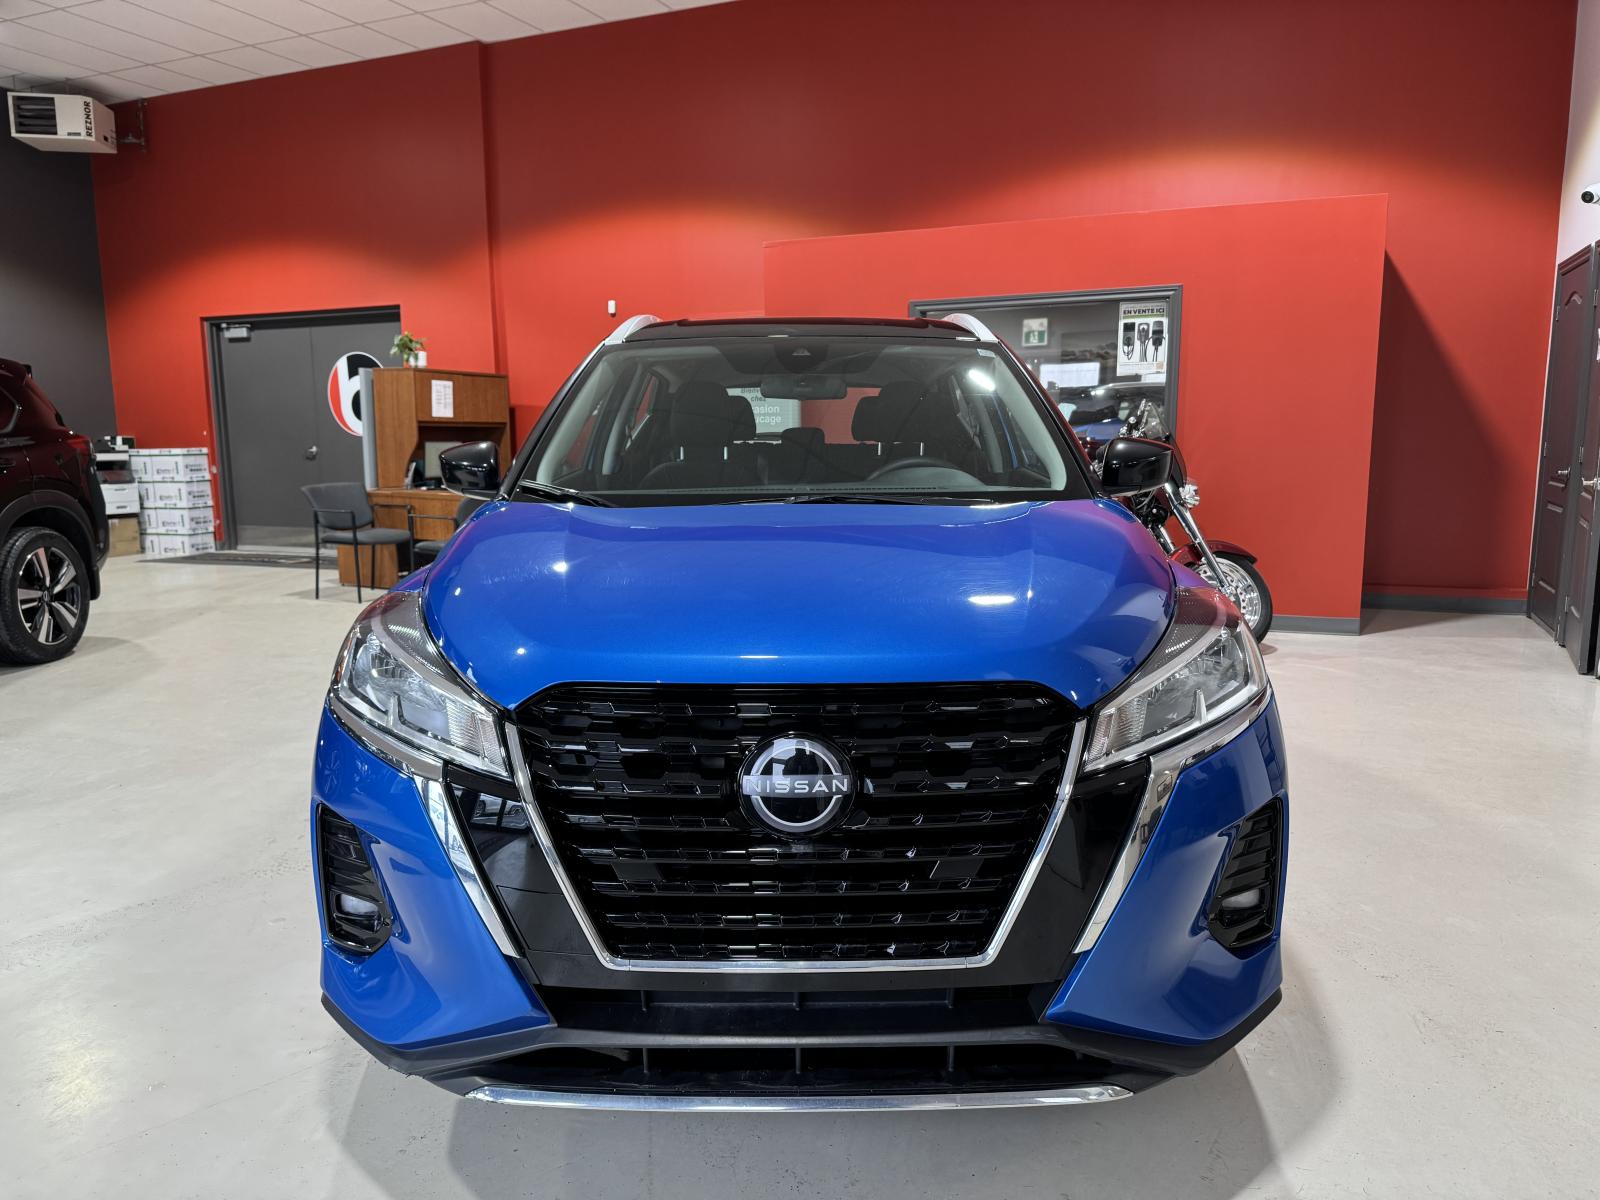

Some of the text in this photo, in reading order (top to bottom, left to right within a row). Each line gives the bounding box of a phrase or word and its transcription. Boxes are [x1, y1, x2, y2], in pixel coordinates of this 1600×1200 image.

[83, 100, 93, 137] REZNOR
[752, 404, 780, 414] asion
[745, 778, 848, 794] NISSAN
